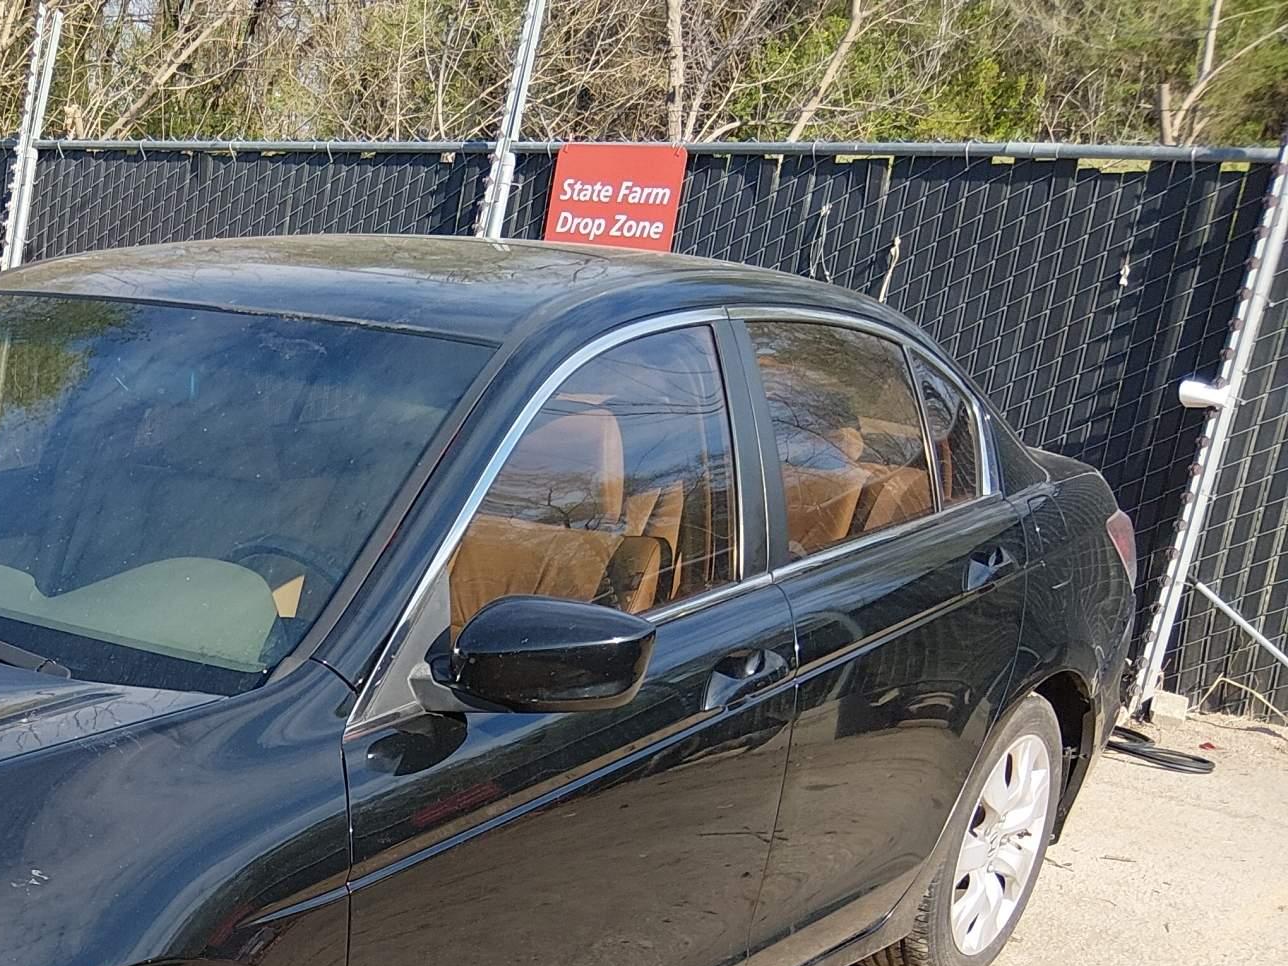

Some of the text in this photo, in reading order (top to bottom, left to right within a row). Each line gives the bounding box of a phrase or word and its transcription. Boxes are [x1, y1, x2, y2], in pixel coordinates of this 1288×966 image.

[559, 178, 671, 205] State Farm
[555, 211, 664, 240] Drop Zone
